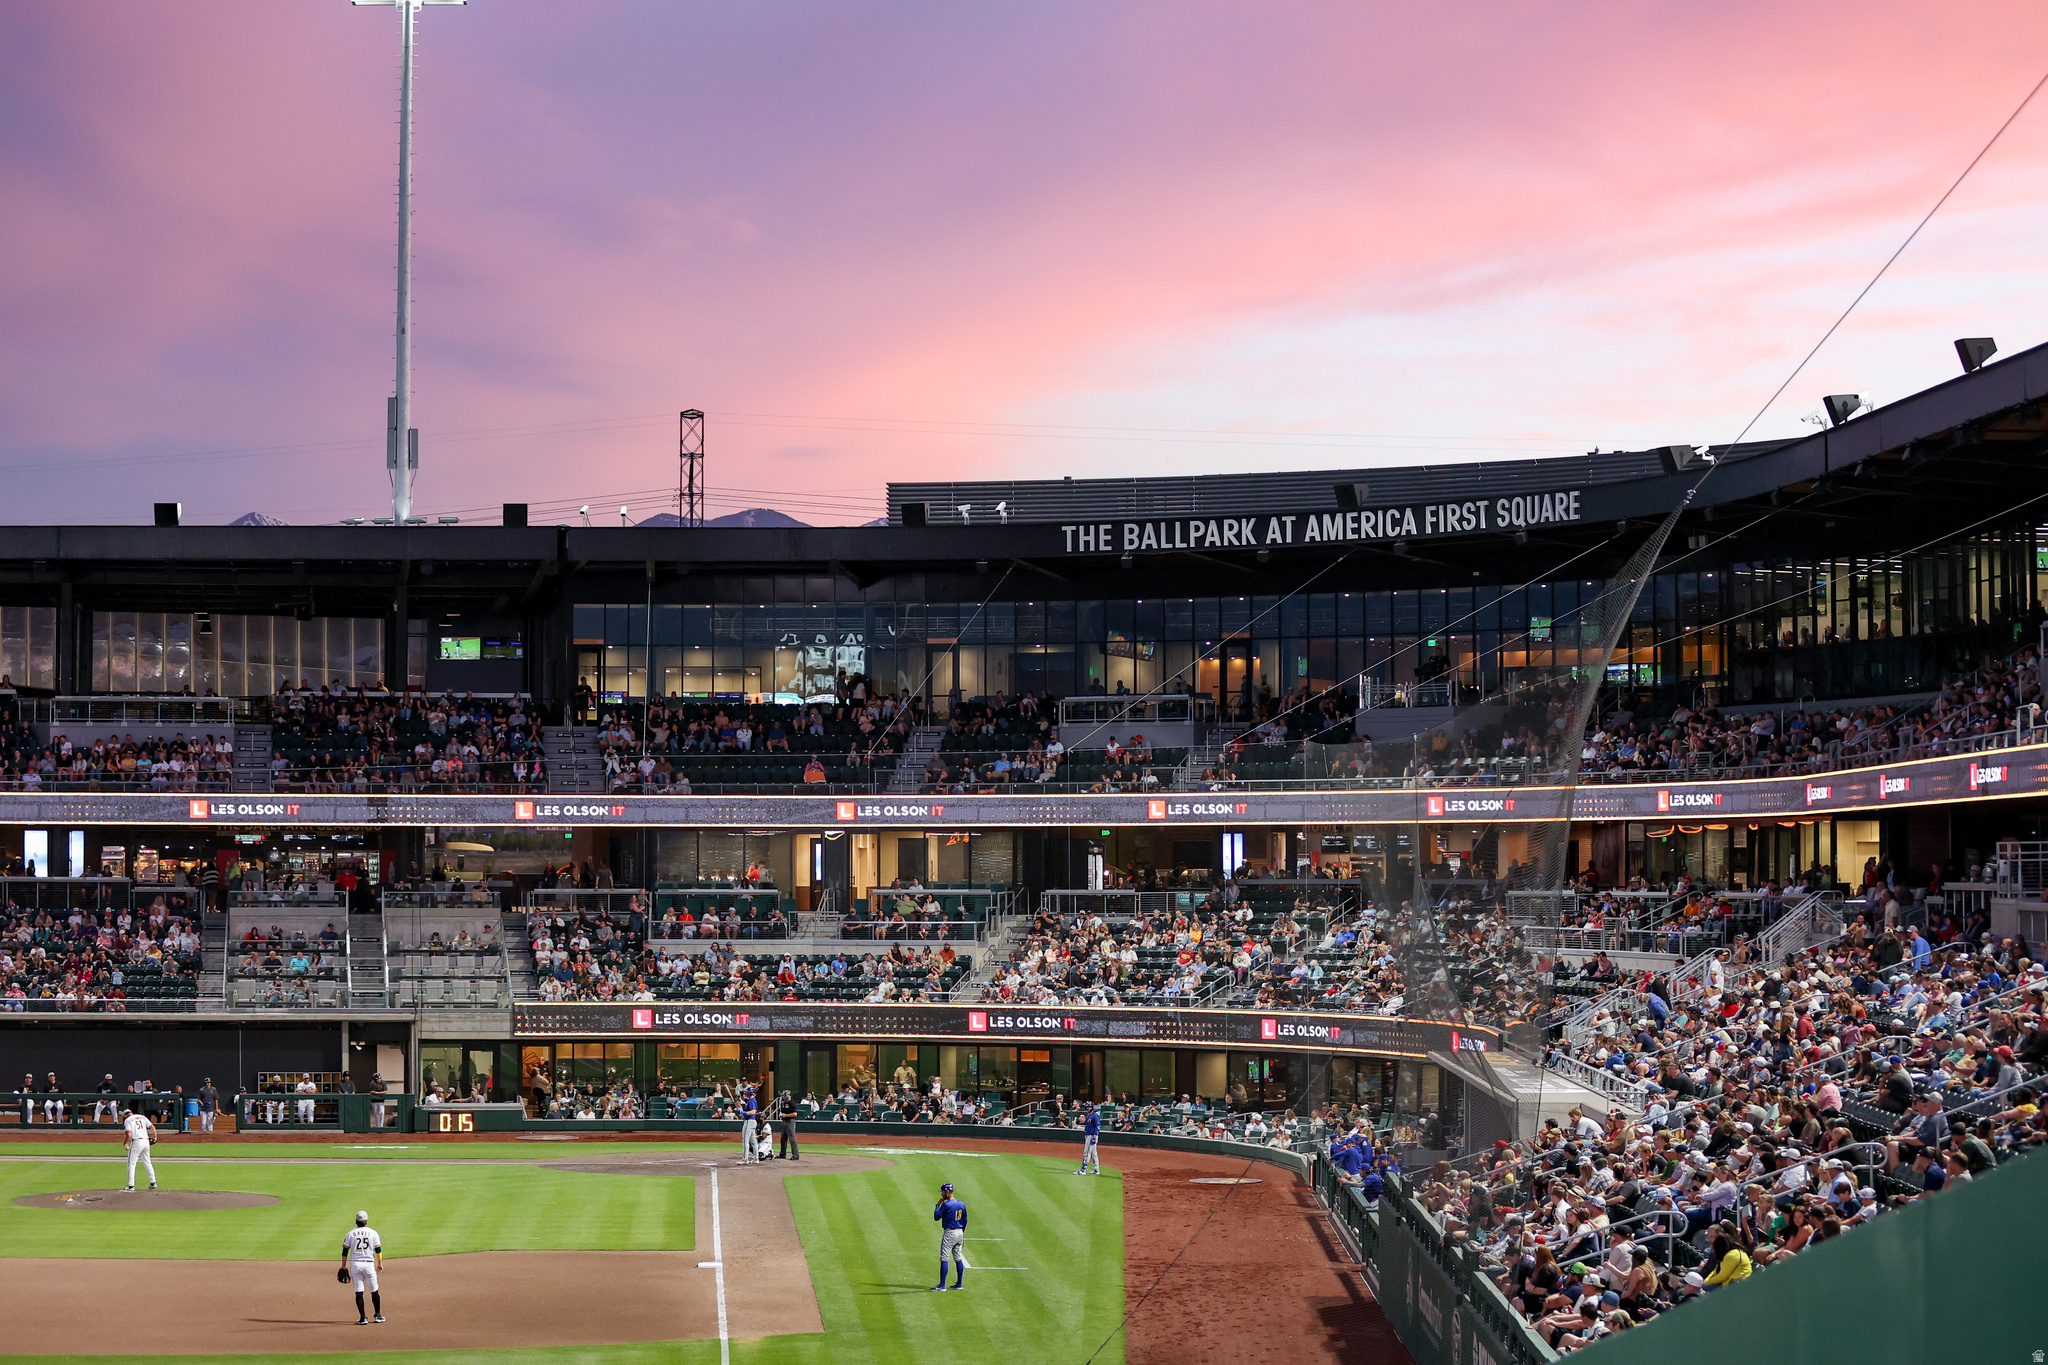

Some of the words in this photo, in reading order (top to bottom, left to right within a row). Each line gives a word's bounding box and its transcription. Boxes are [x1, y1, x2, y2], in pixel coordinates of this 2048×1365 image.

[1061, 524, 1113, 552] THE
[1123, 518, 1257, 551] BALLPARK
[1265, 516, 1296, 544] AT
[1304, 508, 1417, 542] AMERICA
[1425, 500, 1489, 534] FIRST
[1497, 490, 1581, 527] SQUARE
[1445, 800, 1465, 811] LES
[1467, 799, 1503, 811] OLSON
[1505, 799, 1516, 810] IT
[1669, 794, 1684, 806] LES
[1685, 794, 1713, 806] OLSON
[211, 804, 235, 815] LES
[238, 804, 284, 815] OLSON
[286, 804, 301, 815] IT
[536, 805, 560, 816] LES
[563, 805, 609, 816] OLSON
[611, 806, 625, 816] IT
[857, 806, 880, 816] LES
[884, 806, 928, 816] OLSON
[931, 806, 945, 816] IT
[1168, 804, 1190, 815] LES
[1193, 803, 1233, 815] OLSON
[1235, 803, 1248, 814] IT
[655, 1013, 680, 1024] LES
[684, 1013, 732, 1024] OLSON
[735, 1014, 750, 1025] IT
[989, 1016, 1013, 1027] LES
[1017, 1017, 1061, 1028] OLSON
[1064, 1018, 1076, 1029] IT
[1277, 1024, 1295, 1036] LES
[1297, 1025, 1328, 1037] OLSON
[1330, 1027, 1340, 1038] IT
[356, 1237, 369, 1250] 25
